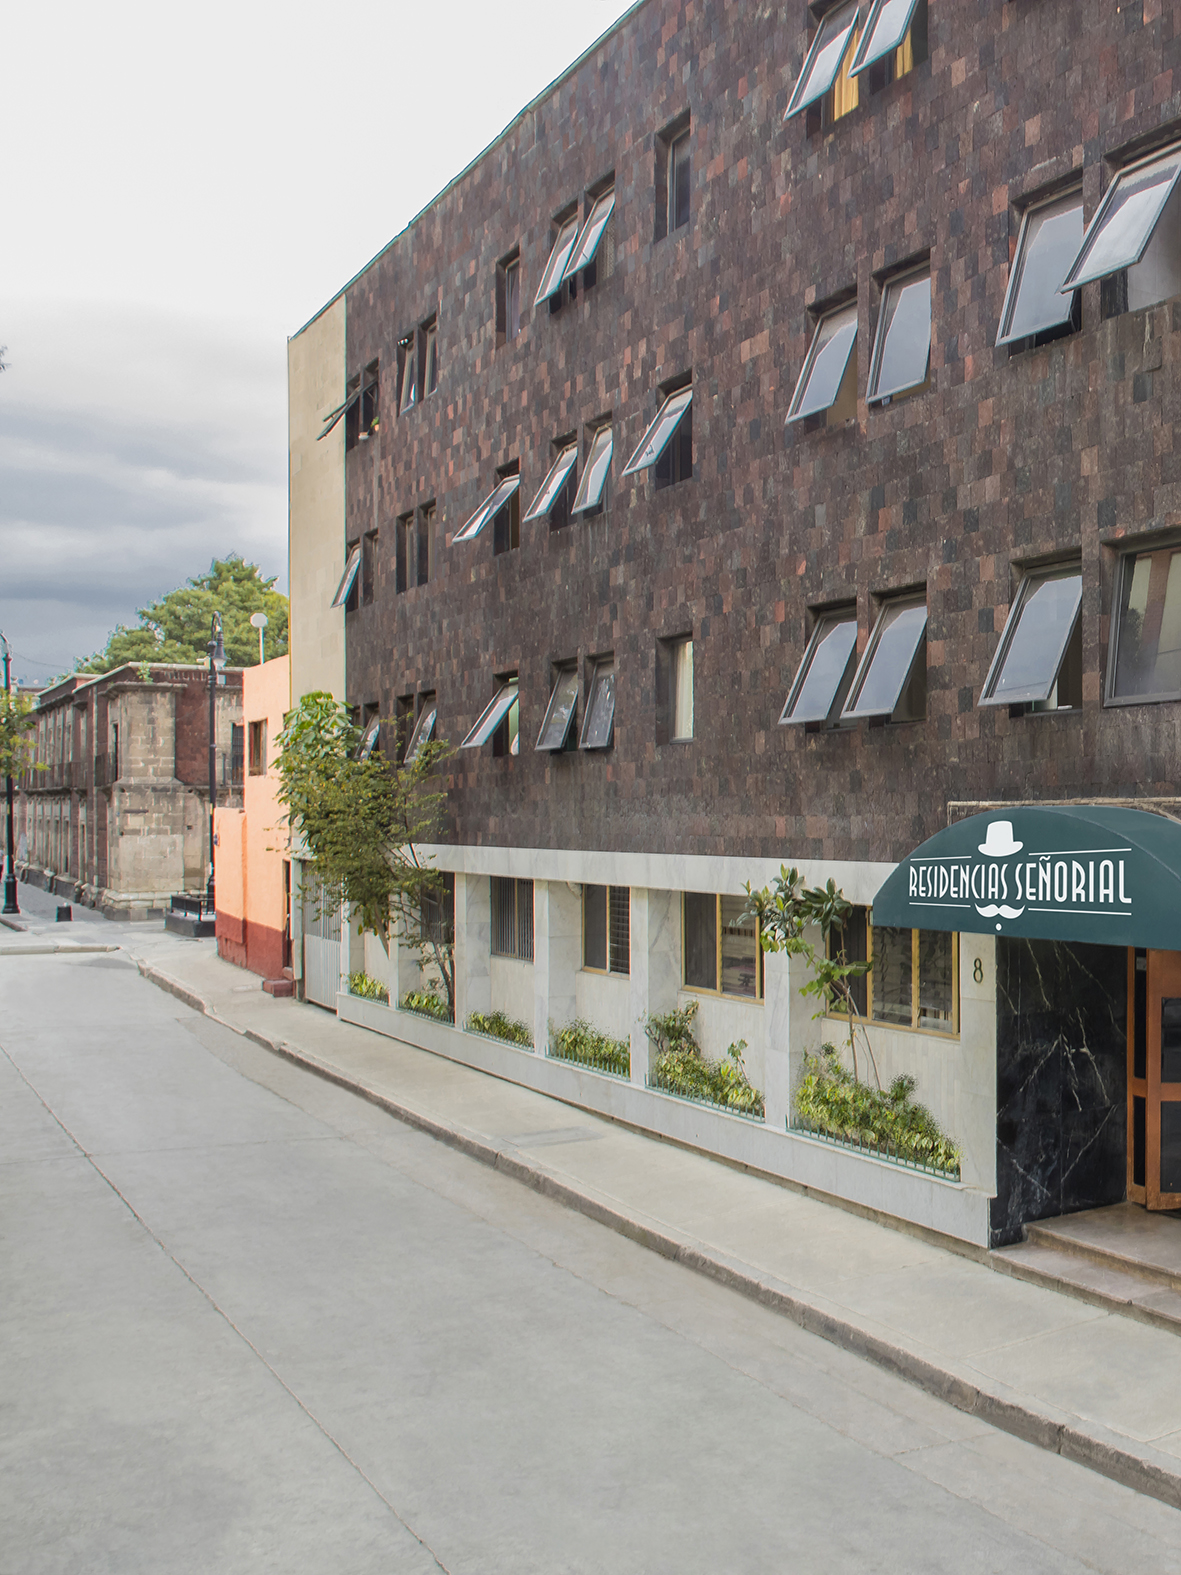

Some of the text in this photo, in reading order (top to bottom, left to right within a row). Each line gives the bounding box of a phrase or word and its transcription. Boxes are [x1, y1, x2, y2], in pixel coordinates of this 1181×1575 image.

[908, 855, 1132, 904] RESIDENCIAS SEÑORIAL
[972, 957, 984, 984] 8
